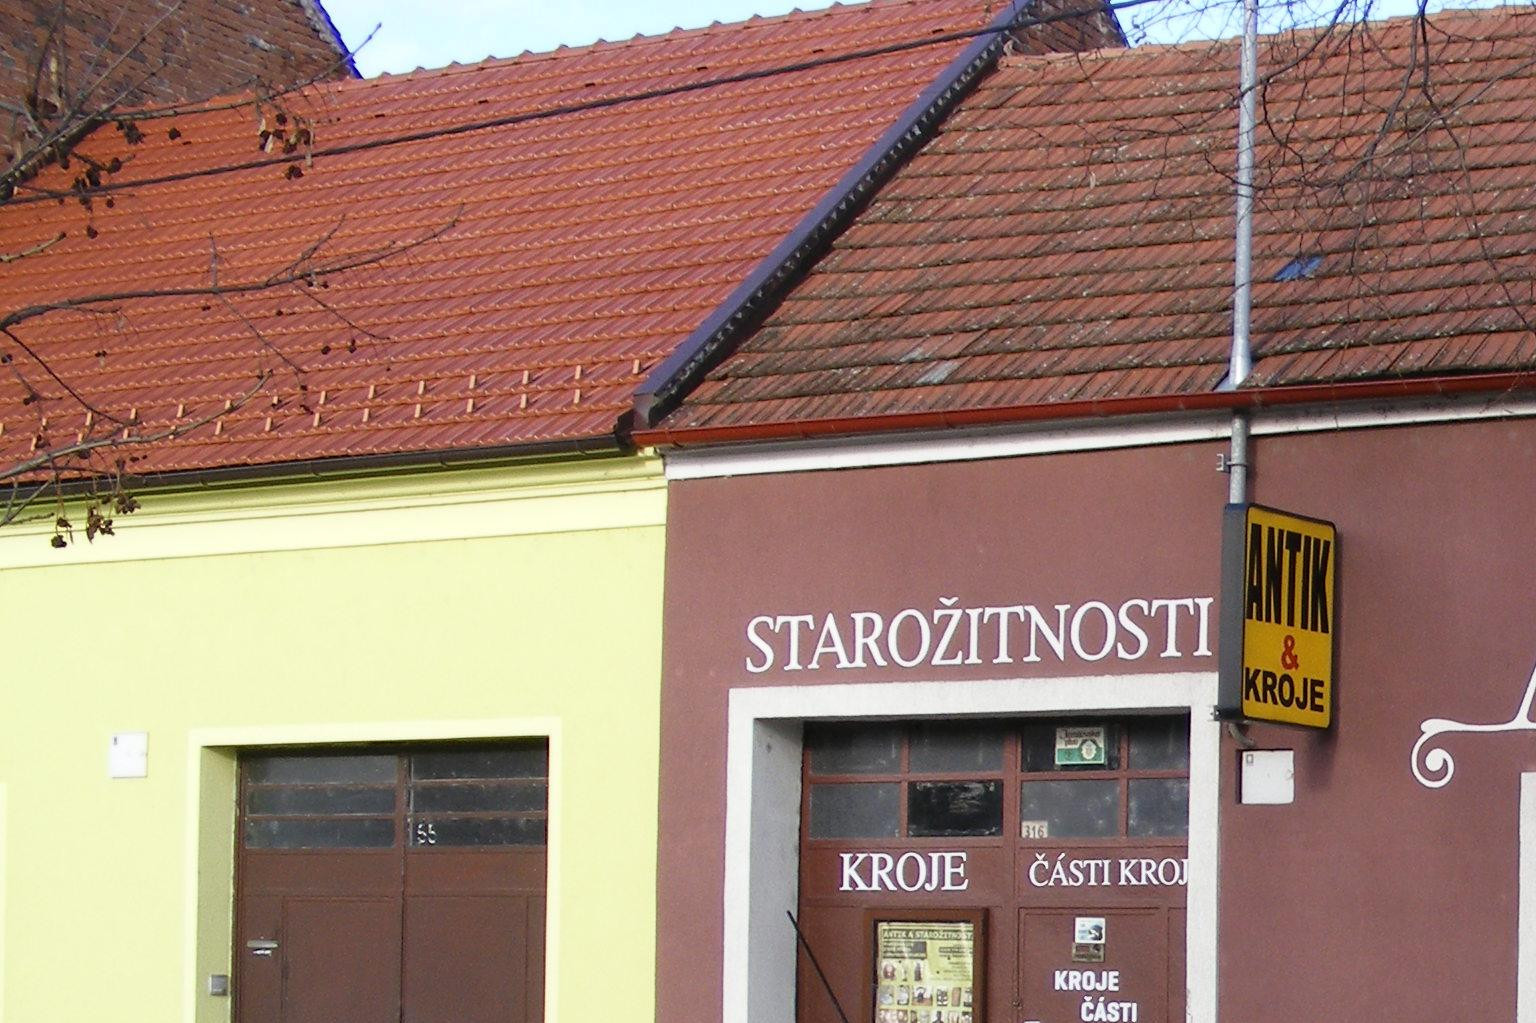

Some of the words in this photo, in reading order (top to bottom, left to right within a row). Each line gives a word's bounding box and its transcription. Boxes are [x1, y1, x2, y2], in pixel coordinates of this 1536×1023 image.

[1246, 523, 1331, 634] ANTIK
[745, 596, 1214, 673] STAROŽITNOSTI
[1281, 635, 1299, 670] &
[1244, 666, 1325, 713] KROJE
[1023, 824, 1046, 838] 316
[839, 851, 969, 892] KROJE
[1029, 853, 1111, 887] ČÁSTI
[1054, 970, 1120, 991] KROJE
[1081, 996, 1138, 1023] ČÁSTI
